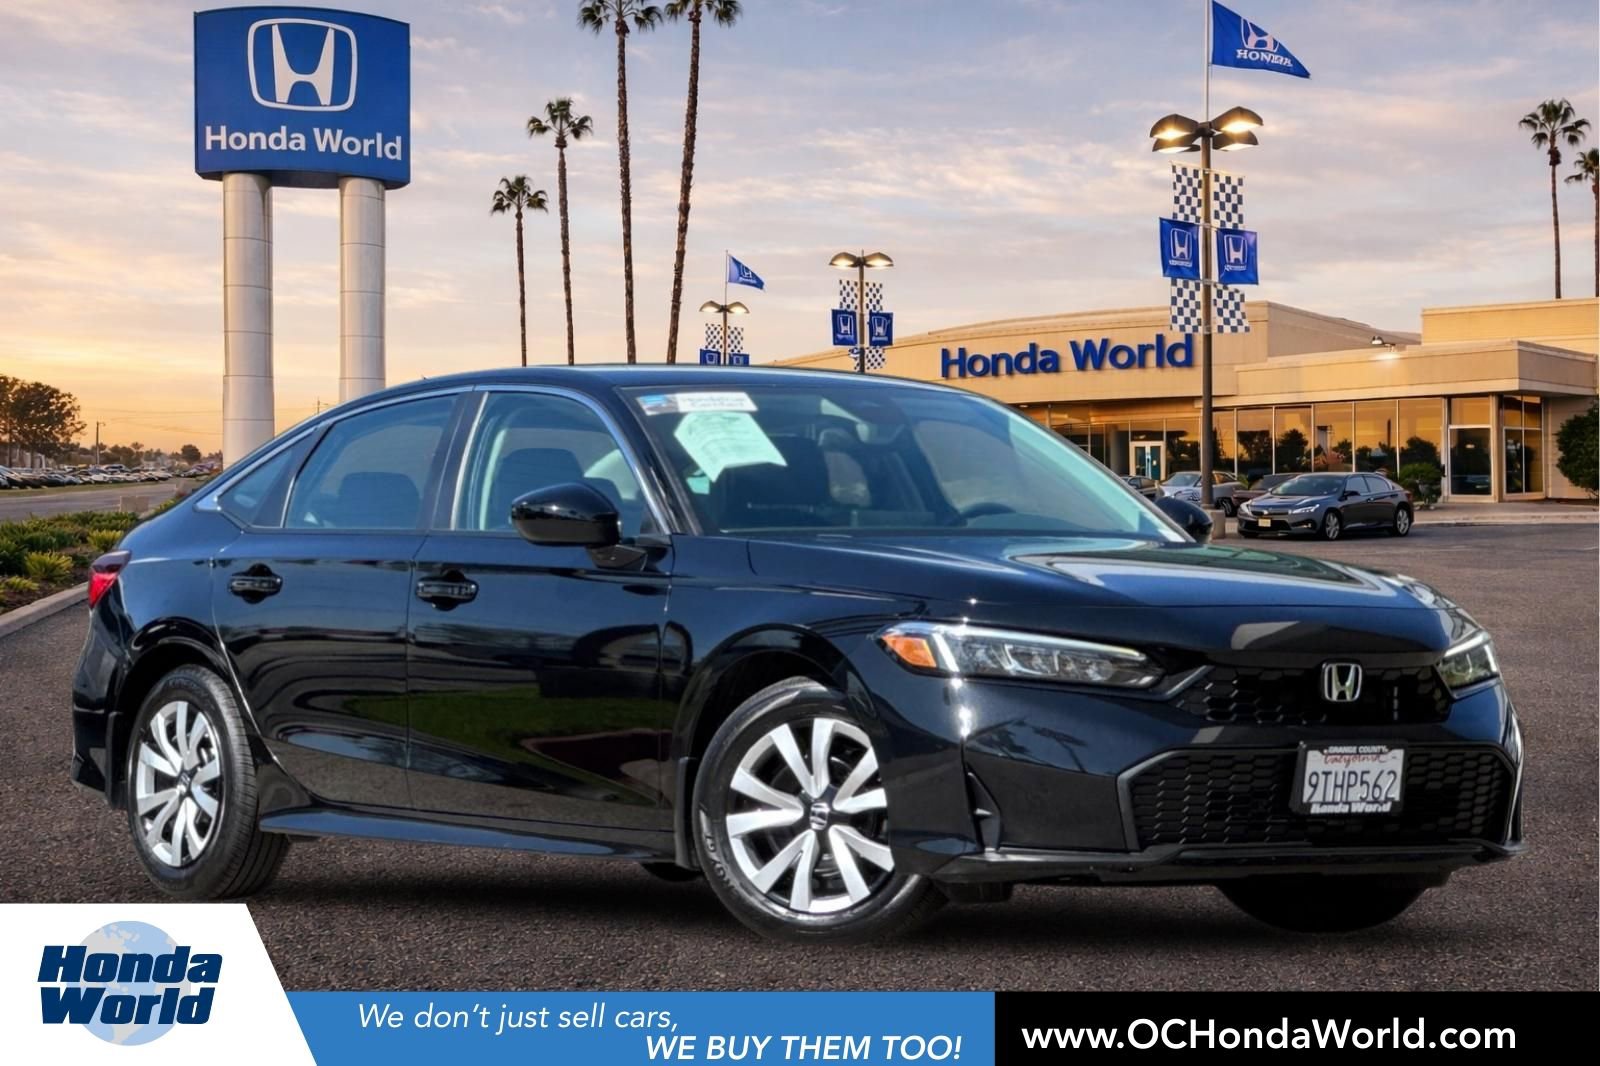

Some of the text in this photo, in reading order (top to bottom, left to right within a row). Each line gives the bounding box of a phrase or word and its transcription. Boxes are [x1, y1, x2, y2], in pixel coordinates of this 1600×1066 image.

[205, 125, 402, 161] Honda World
[940, 333, 1194, 378] Honda World
[1358, 745, 1386, 754] COUNTY
[1307, 769, 1397, 802] 9THP562
